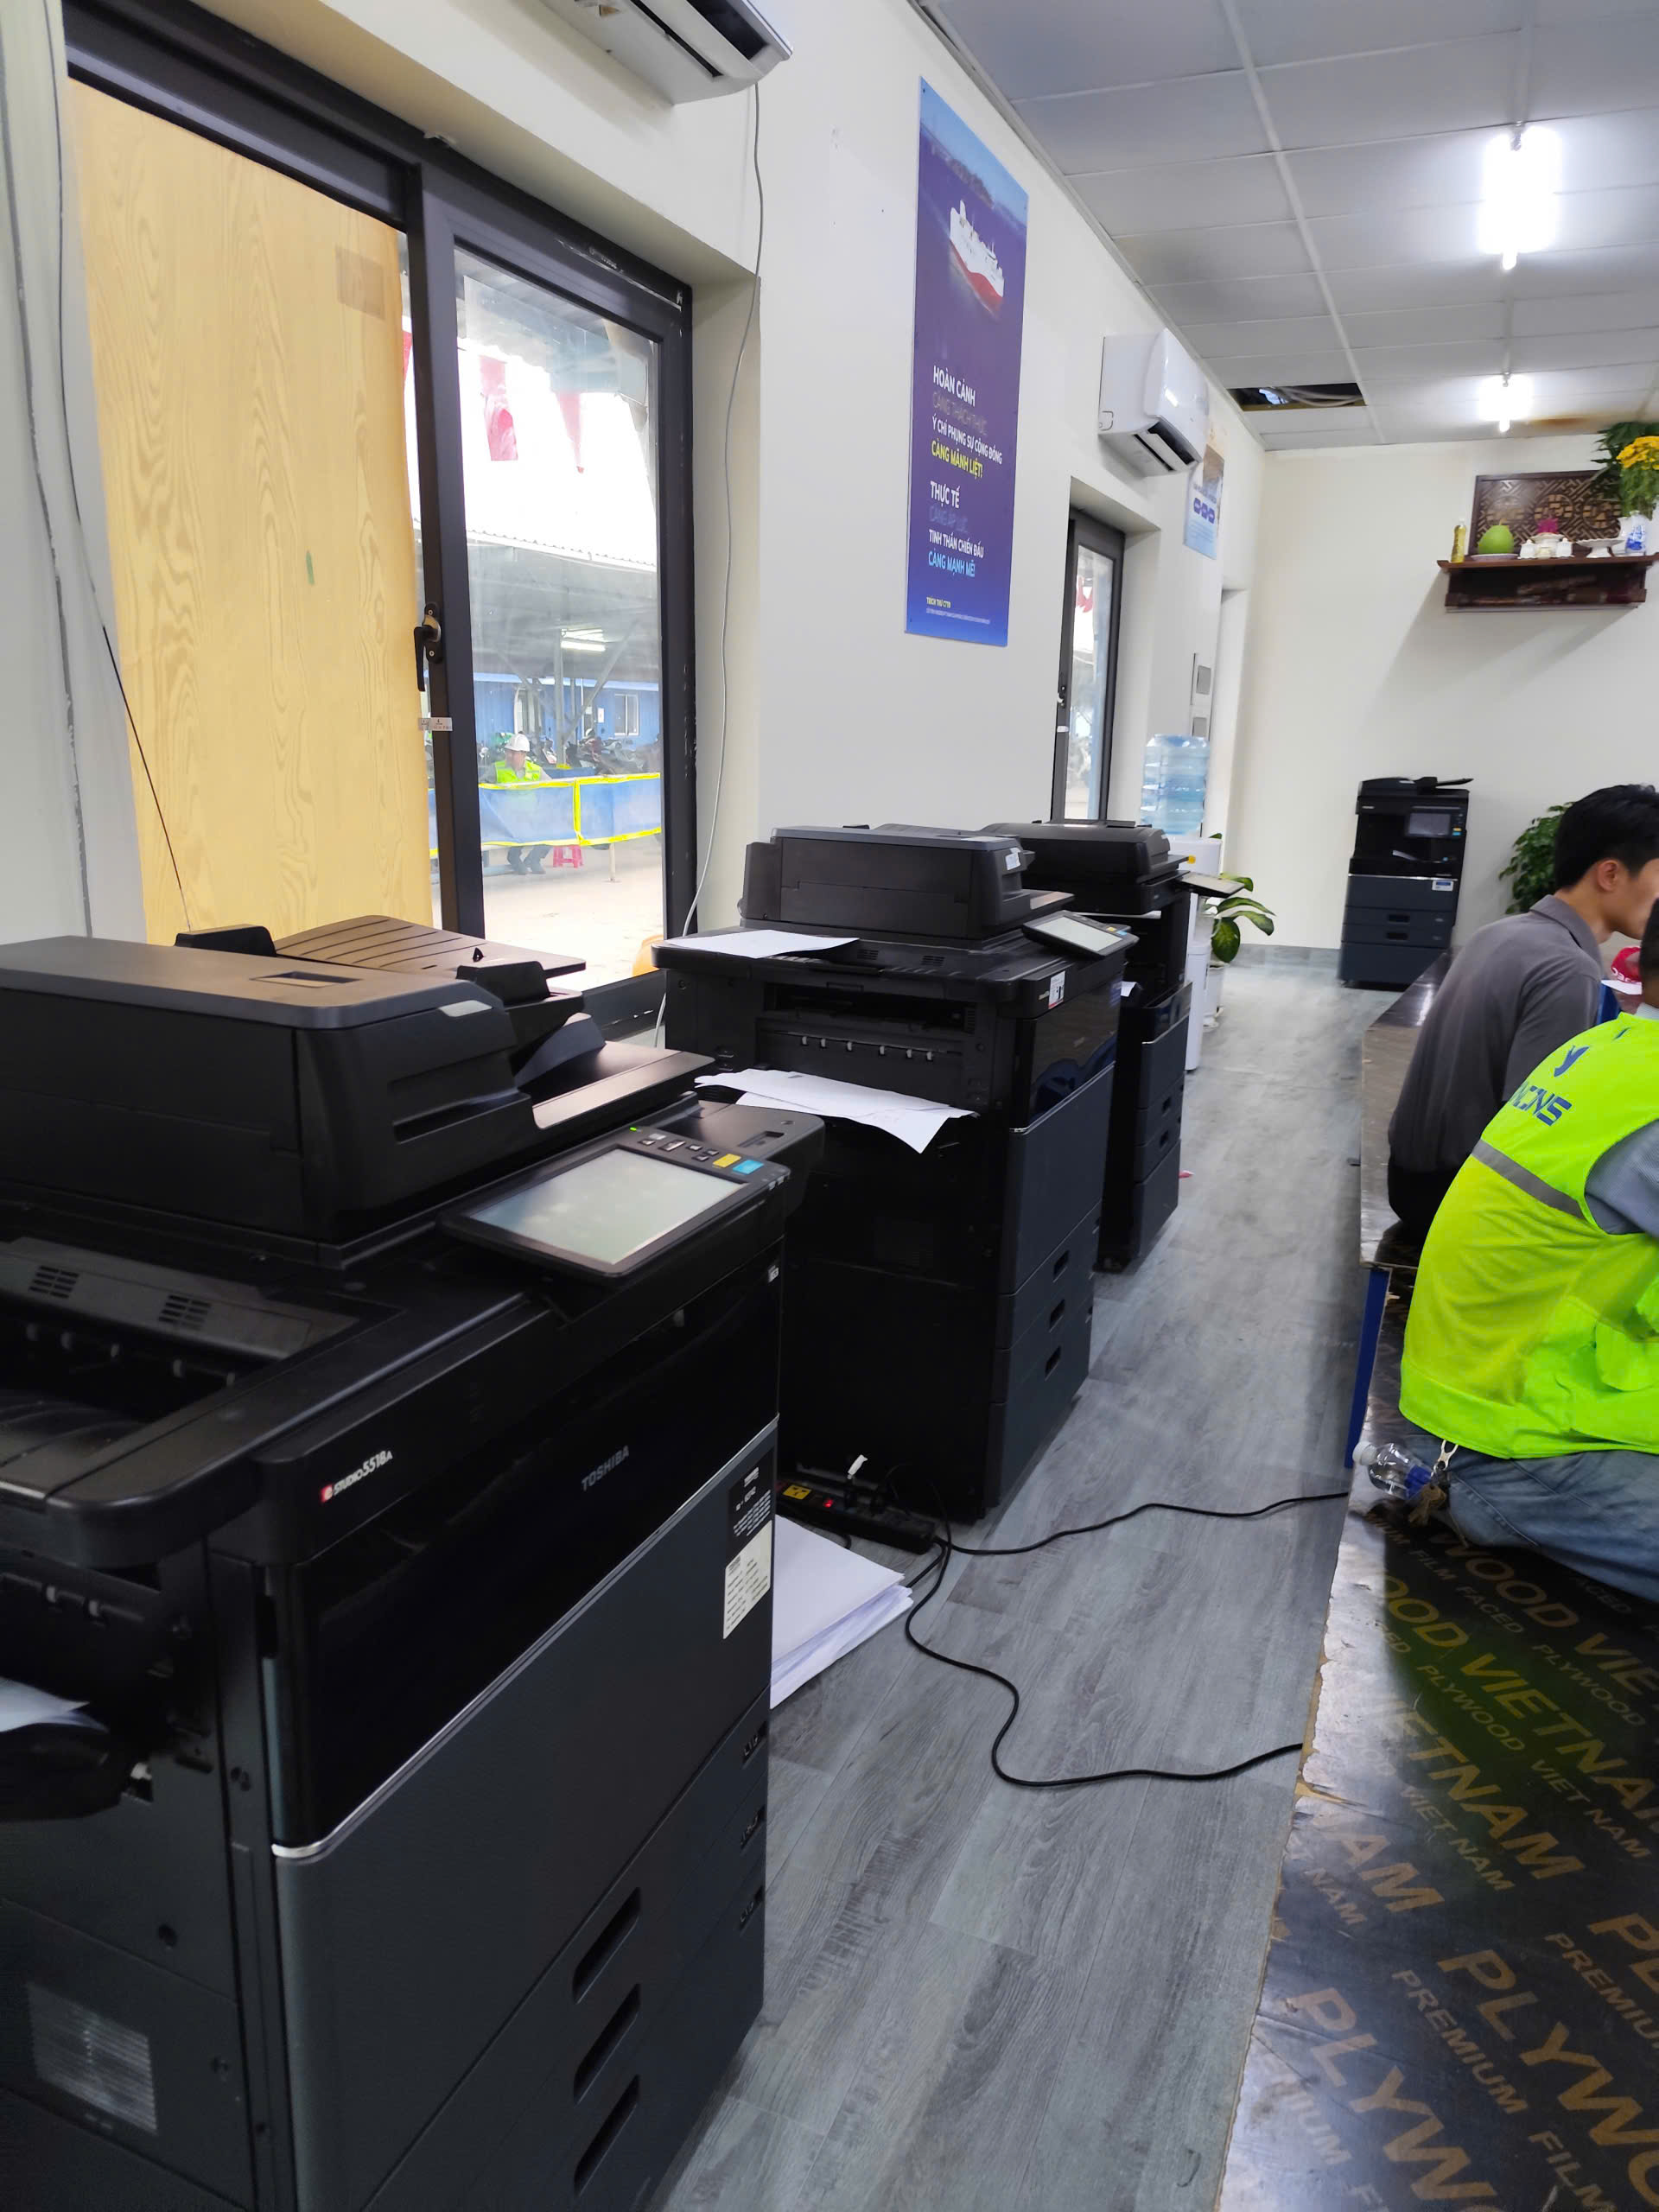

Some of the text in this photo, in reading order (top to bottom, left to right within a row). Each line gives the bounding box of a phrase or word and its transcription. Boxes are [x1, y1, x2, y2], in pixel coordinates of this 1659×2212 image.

[933, 365, 955, 395] HOÀN
[581, 1444, 630, 1493] TOSHIBA
[1417, 1665, 1526, 1751] PLYWOOD
[1531, 1759, 1591, 1803] VIET
[1584, 1808, 1652, 1858] NAM
[1448, 1838, 1516, 1891] NAM
[1392, 1969, 1529, 2115] PREMIUM
